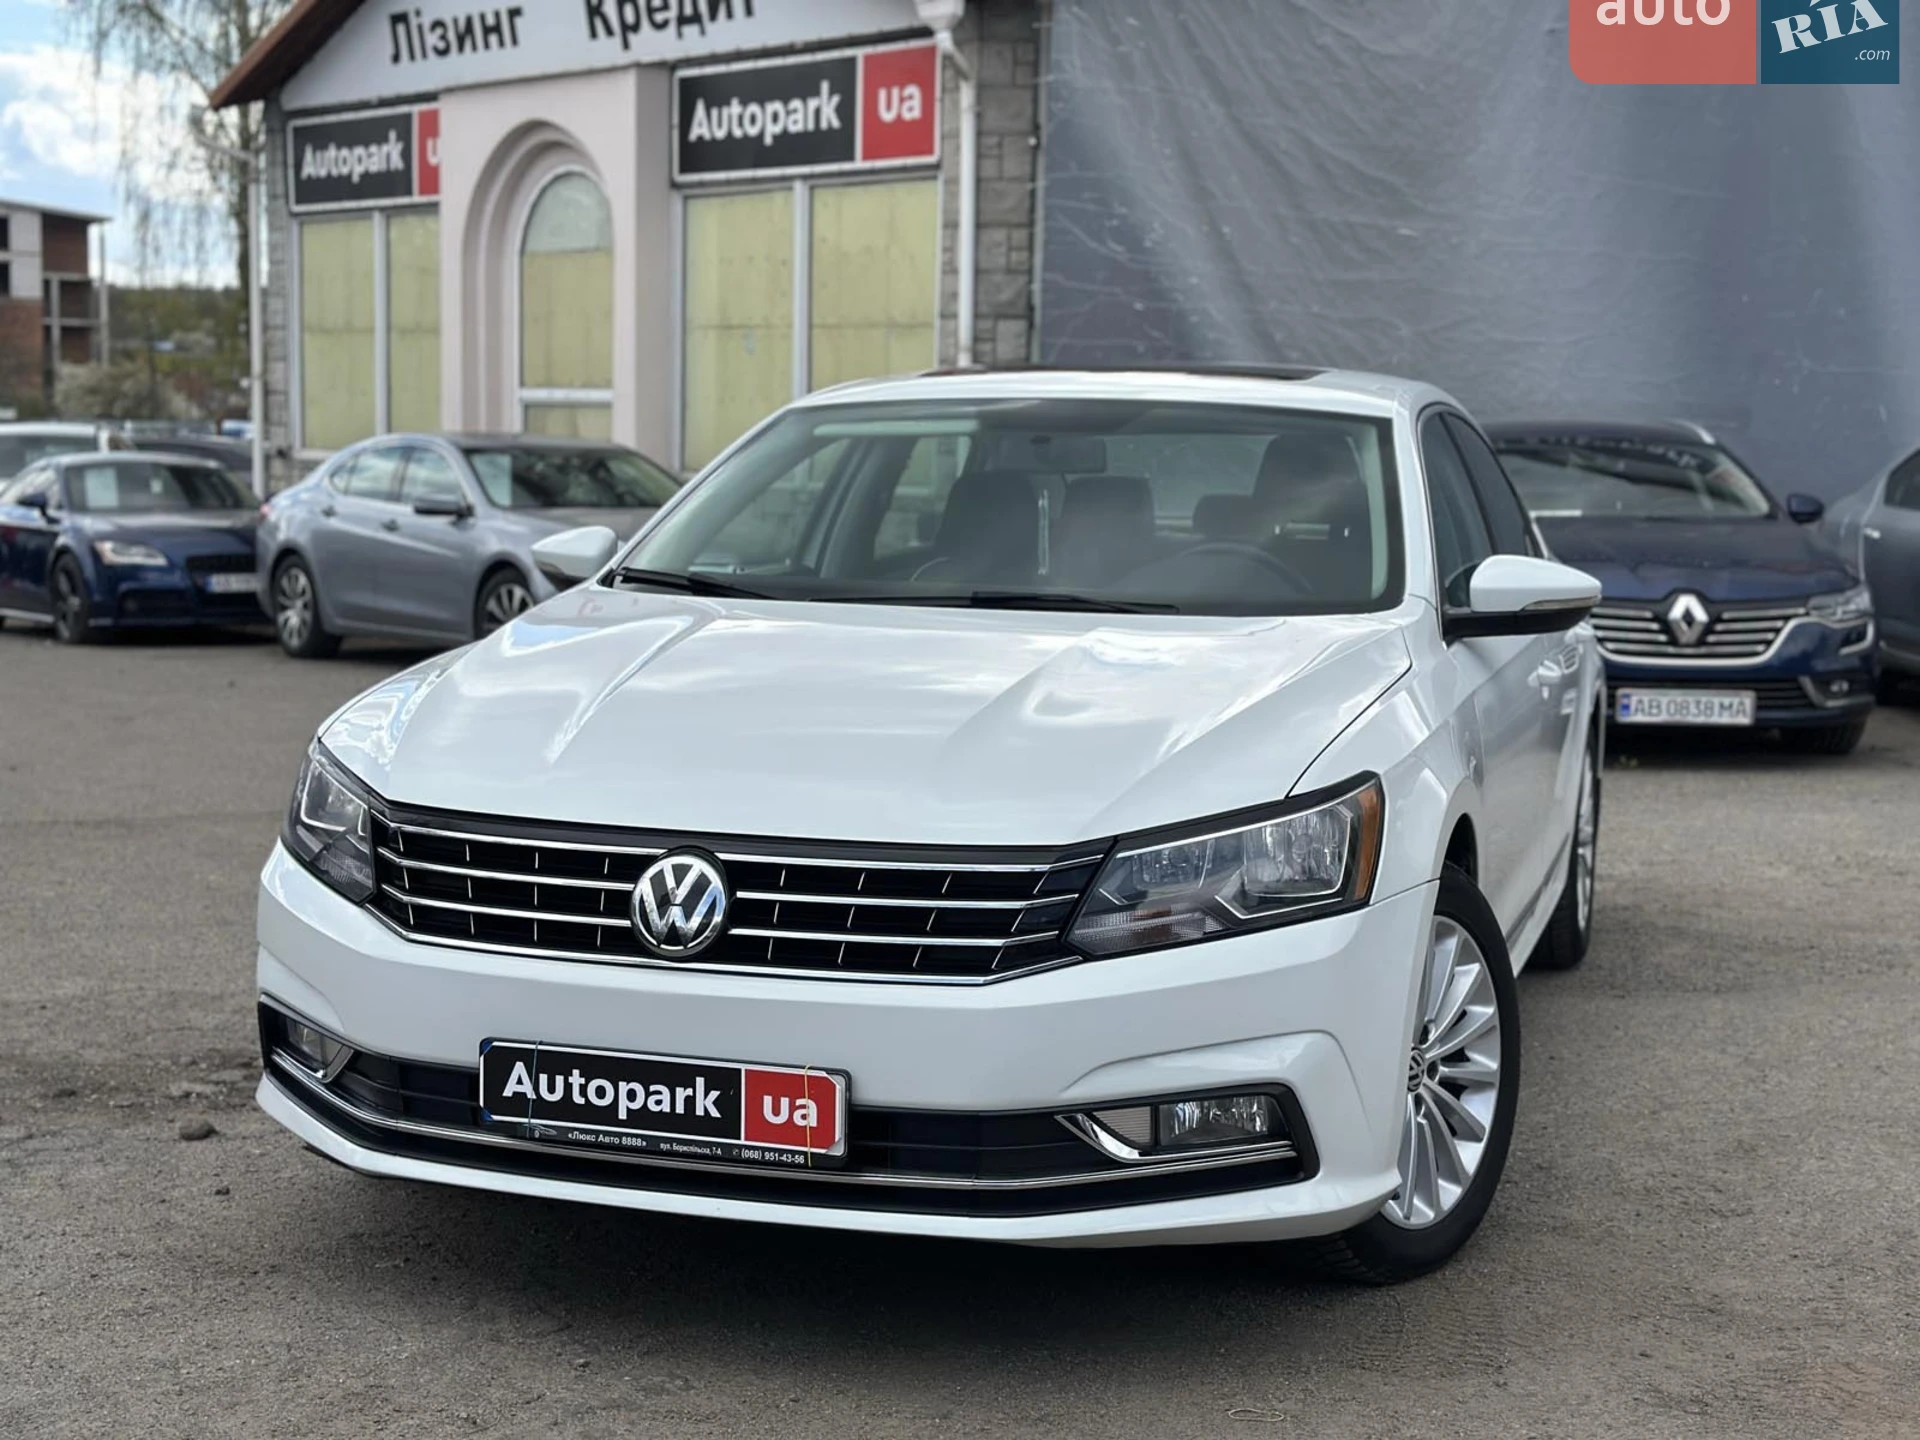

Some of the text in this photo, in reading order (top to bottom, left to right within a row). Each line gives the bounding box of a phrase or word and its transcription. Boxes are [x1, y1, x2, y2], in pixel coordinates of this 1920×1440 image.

[390, 0, 754, 64] Лізинг Кредит
[688, 80, 922, 146] Autopark ua
[300, 129, 405, 184] Autopark
[1633, 698, 1748, 719] AB 0838 MA
[502, 1060, 818, 1128] Autopark ua
[598, 1134, 620, 1144] Авто
[741, 1148, 805, 1165] (068) 951-43-56
